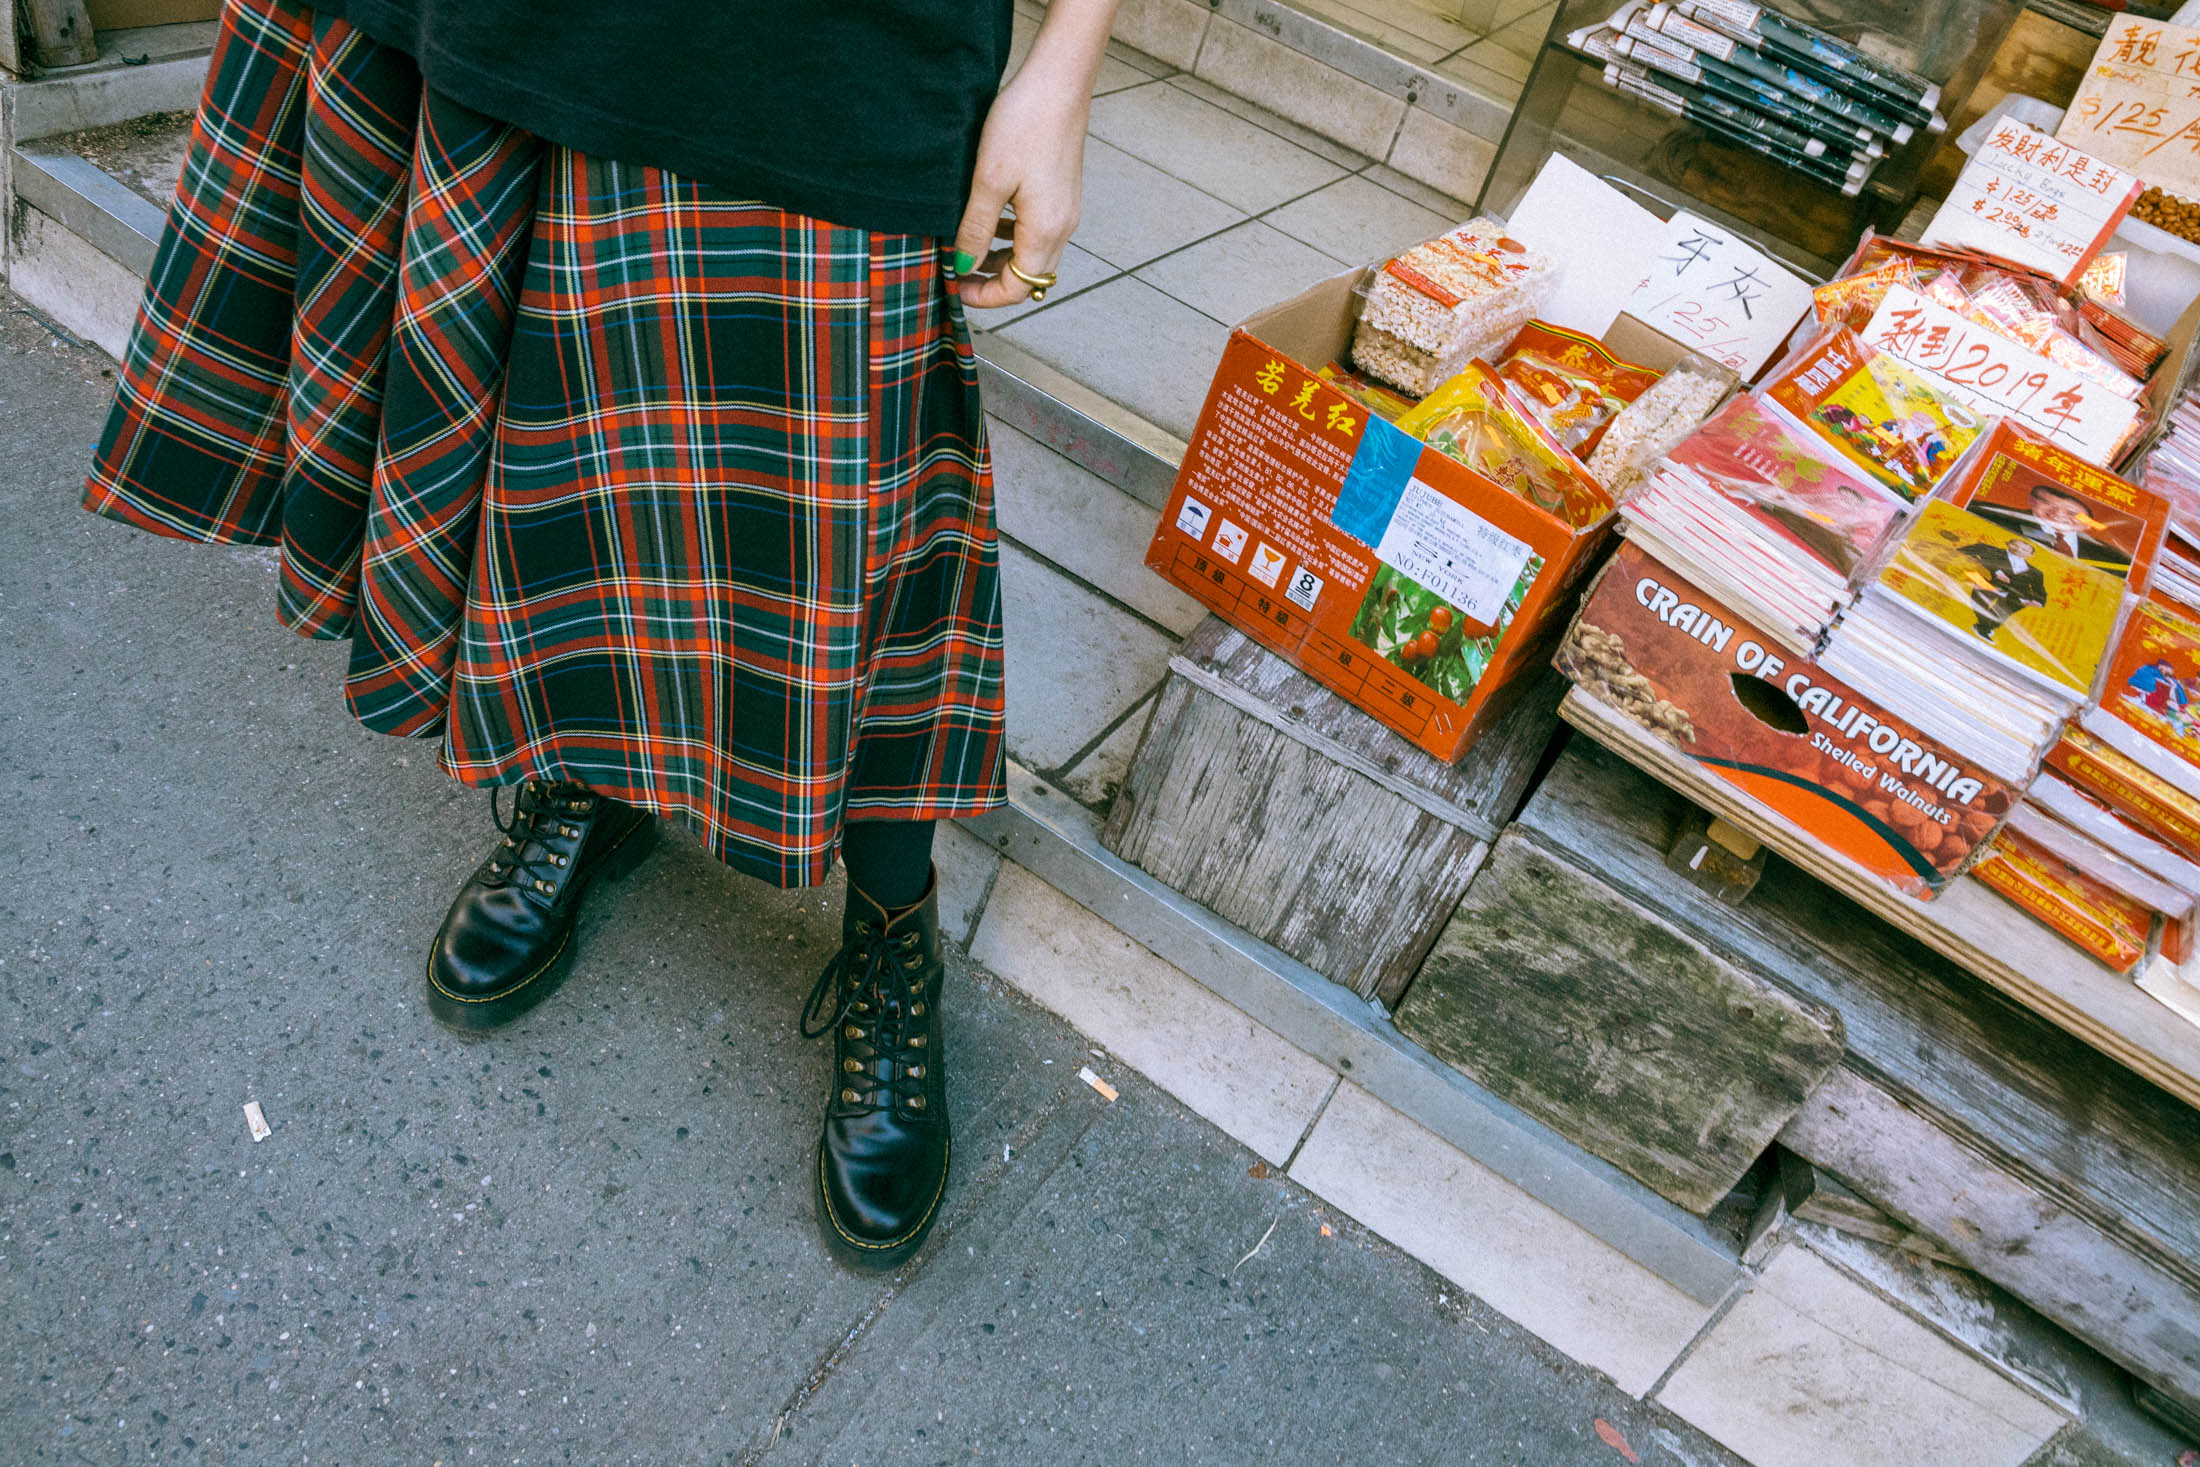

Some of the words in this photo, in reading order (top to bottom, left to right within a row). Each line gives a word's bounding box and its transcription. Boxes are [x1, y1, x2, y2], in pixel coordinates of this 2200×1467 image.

[1299, 572, 1316, 592] 8
[1411, 549, 1432, 565] NEW
[1438, 565, 1464, 585] YORK
[1634, 577, 1736, 654] CRAIN
[1735, 640, 1785, 681] OF
[1785, 672, 1984, 806] CALIFORNIA
[1810, 731, 1878, 780] Shelled
[1879, 772, 1953, 826] Walnuts
